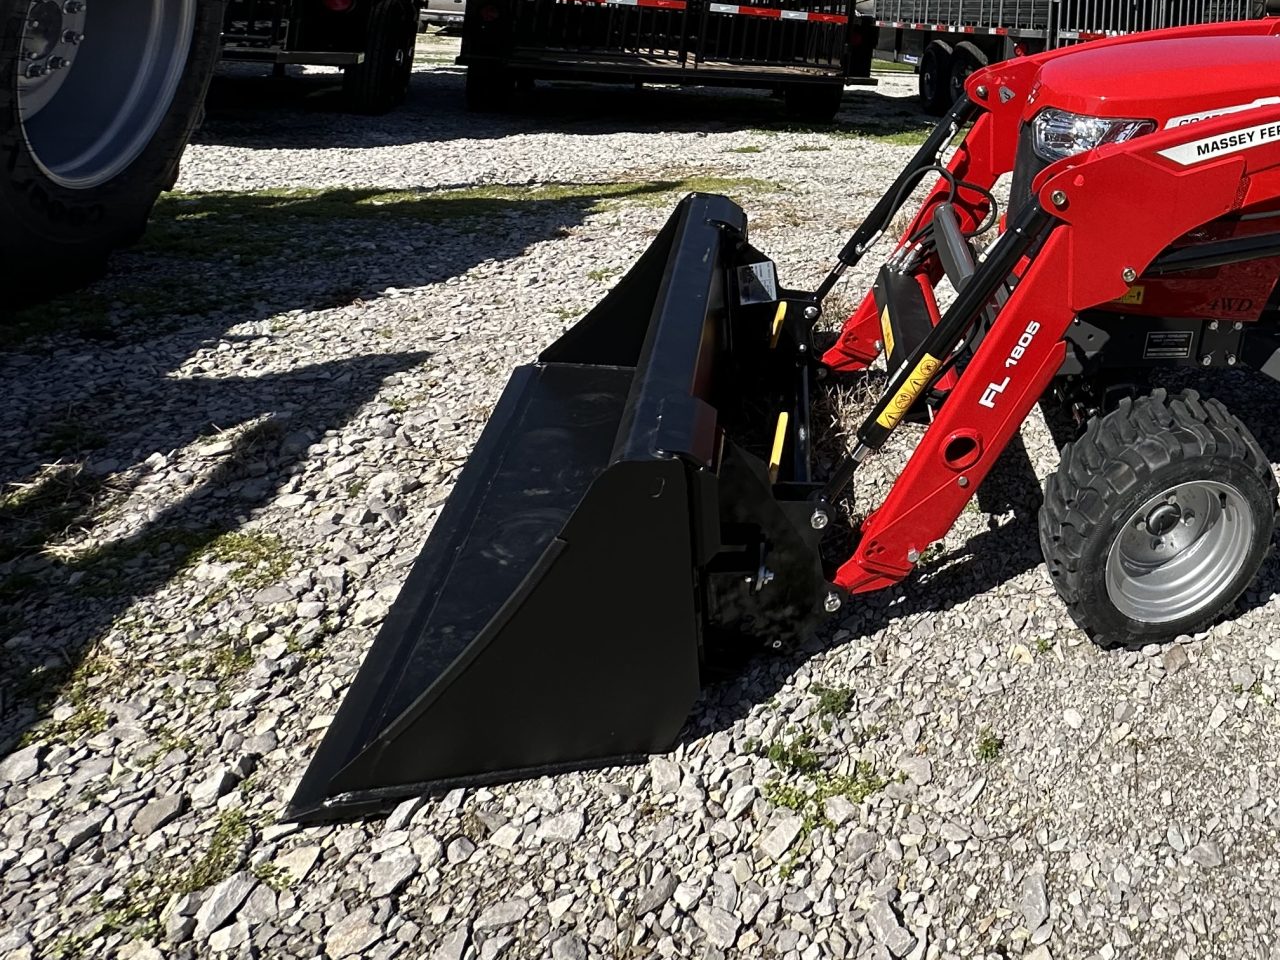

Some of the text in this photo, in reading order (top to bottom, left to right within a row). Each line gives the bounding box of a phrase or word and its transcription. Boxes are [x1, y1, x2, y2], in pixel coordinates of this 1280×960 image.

[1197, 131, 1255, 156] MASSEY
[1207, 297, 1254, 312] 4WD
[978, 320, 1040, 409] FL 1805
